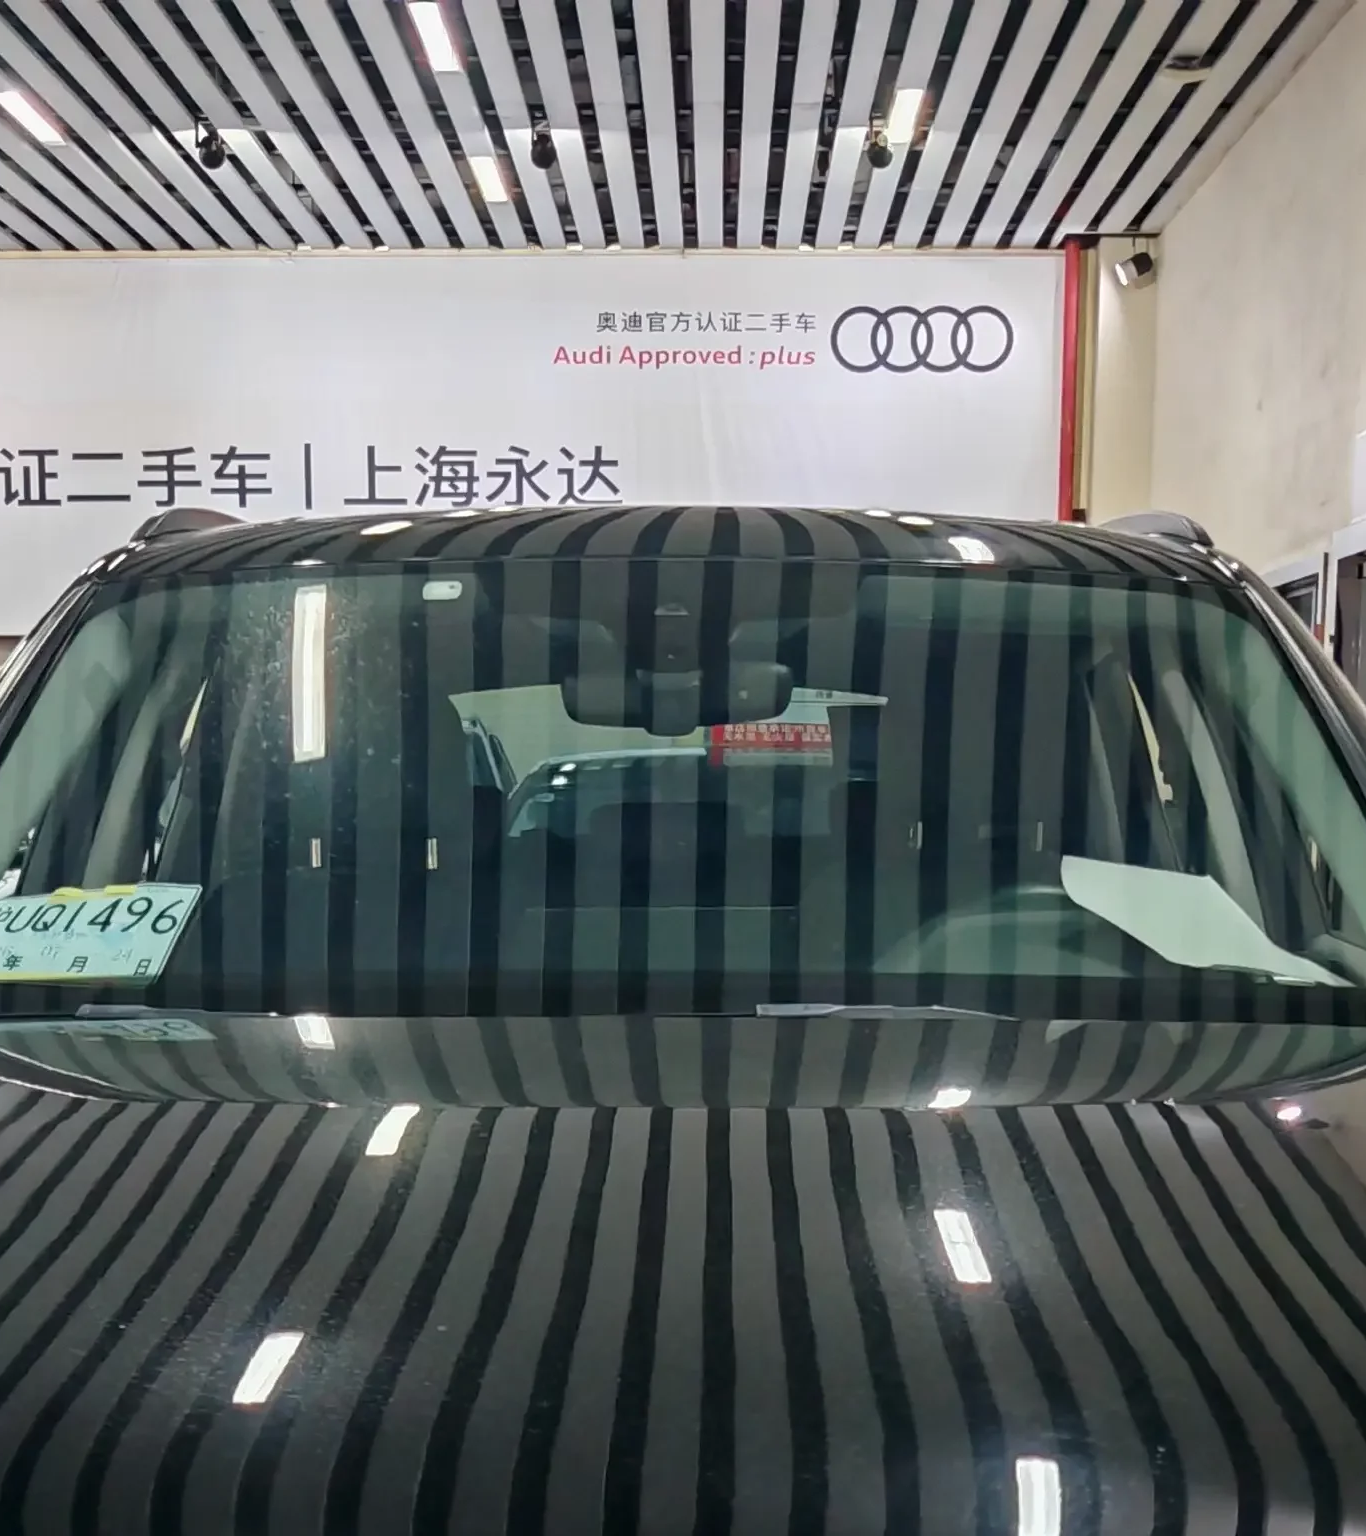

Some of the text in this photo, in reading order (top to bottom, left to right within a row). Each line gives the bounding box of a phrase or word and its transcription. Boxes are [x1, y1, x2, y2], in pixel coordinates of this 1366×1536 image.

[596, 311, 816, 333] 奥迪官方认证二手车
[553, 345, 612, 364] Audi
[618, 345, 742, 370] Approved
[343, 444, 623, 509] 上海永达
